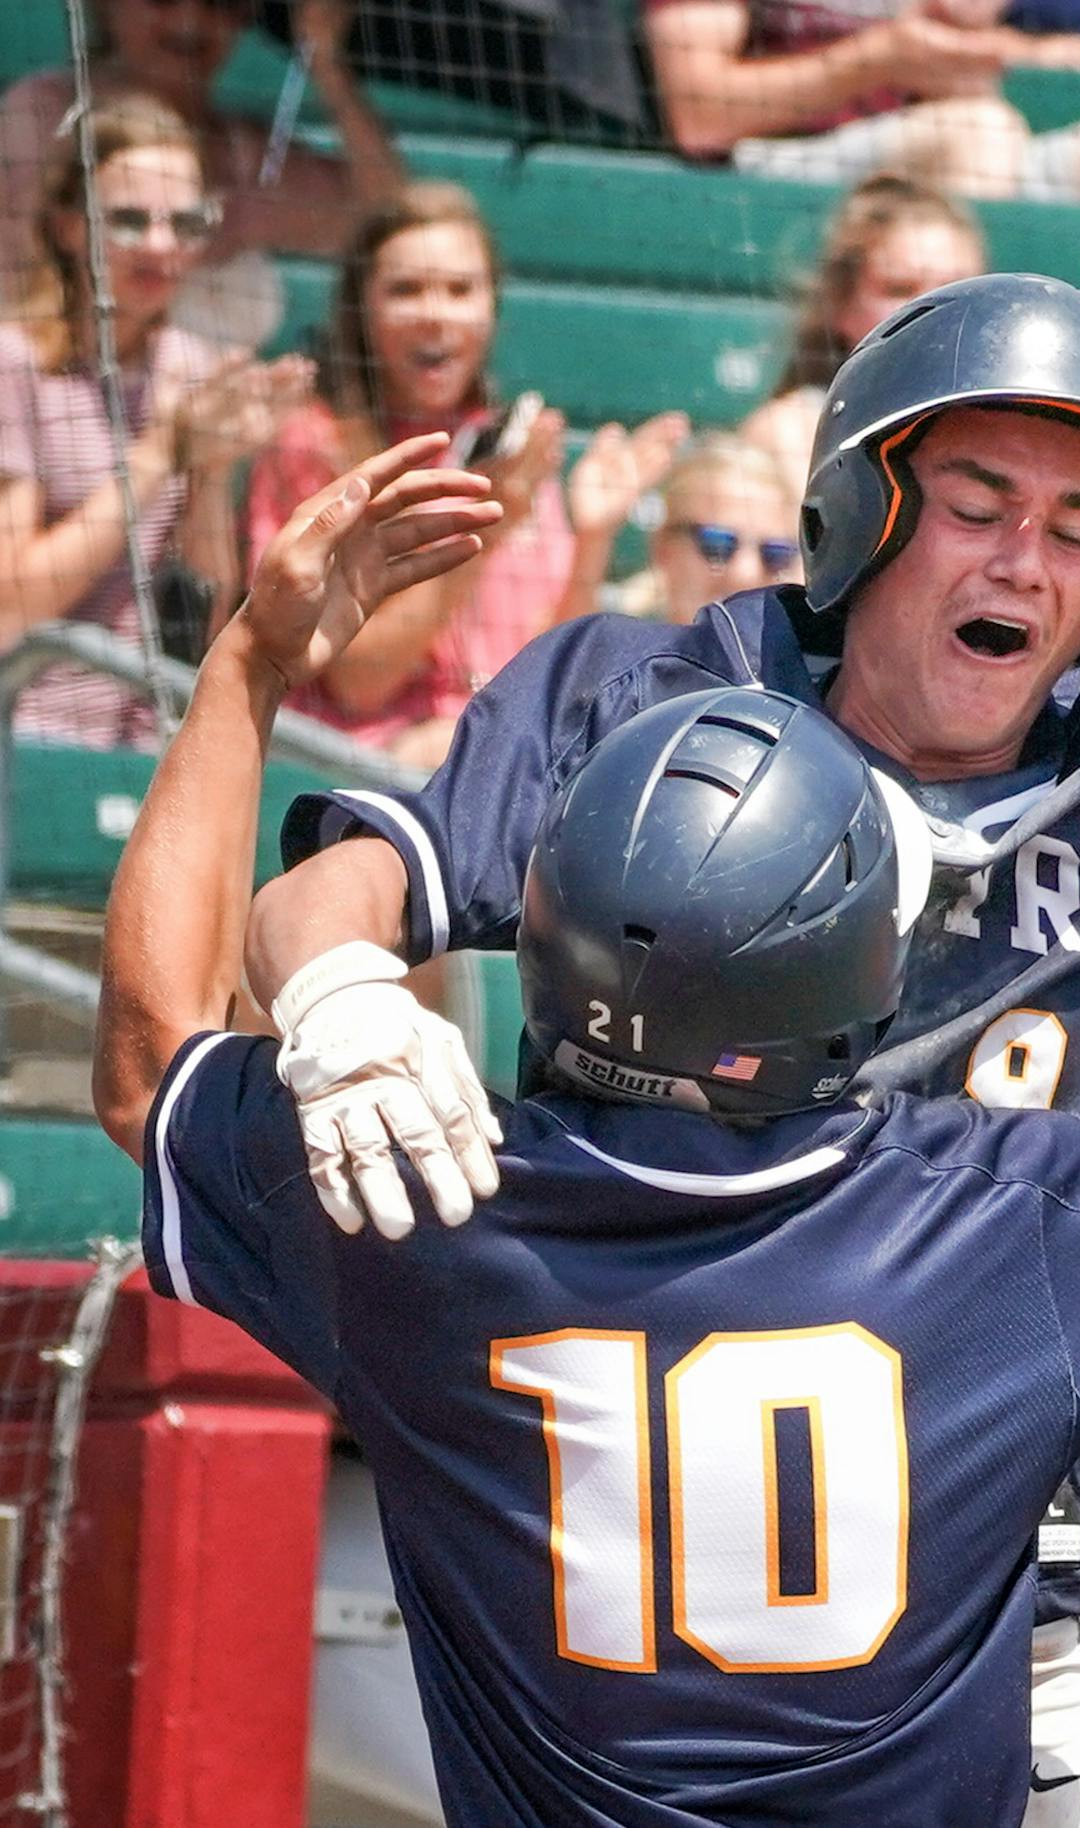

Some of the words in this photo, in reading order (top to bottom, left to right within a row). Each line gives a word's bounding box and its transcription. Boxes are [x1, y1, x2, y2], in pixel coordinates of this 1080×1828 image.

[588, 1000, 645, 1052] 21
[575, 1051, 677, 1098] schutt
[489, 1321, 909, 1674] 10
